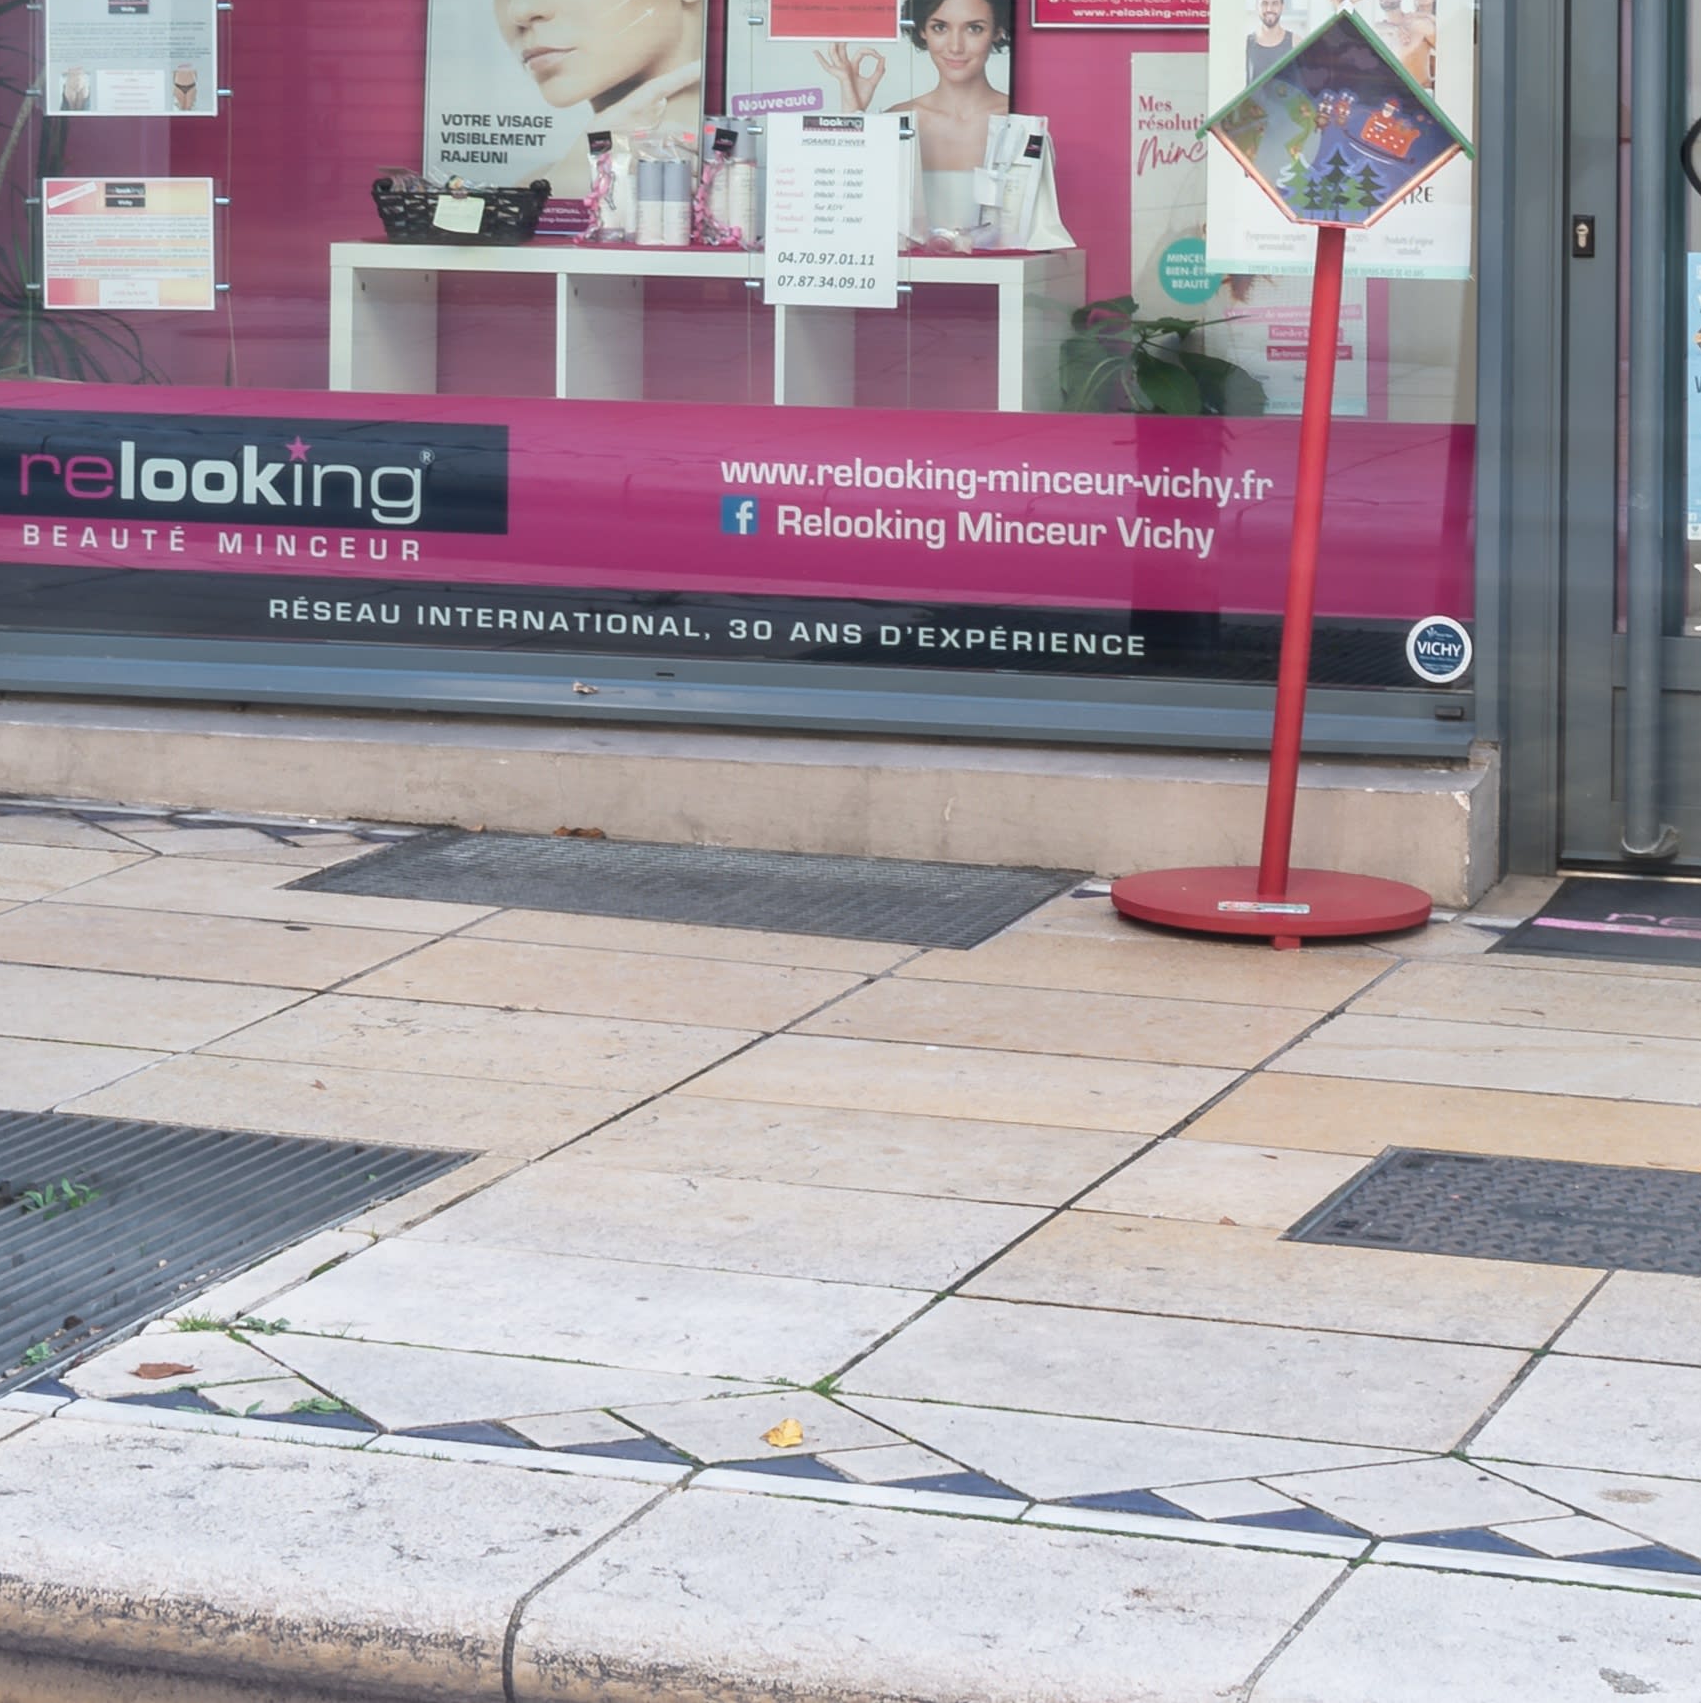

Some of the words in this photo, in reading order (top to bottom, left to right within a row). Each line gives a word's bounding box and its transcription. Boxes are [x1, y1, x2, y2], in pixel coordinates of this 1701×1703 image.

[737, 92, 817, 113] Nouveauté
[1138, 95, 1172, 112] Mes
[442, 114, 491, 127] VOTRE
[496, 115, 554, 129] VISAGE
[440, 131, 546, 147] VISIBLEMENT
[440, 150, 508, 164] RAJEUNI
[777, 251, 875, 266] 04.70.97.01.11
[777, 275, 876, 290] 07.87.34.09.10
[1171, 275, 1210, 289] BEAUTÉ
[720, 455, 1275, 509] www.relooking-minceur-vichy.fr
[776, 505, 947, 550] Relooking
[957, 510, 1107, 548] Minceur
[1117, 515, 1216, 559] Vichy
[22, 524, 187, 553] BEAUTÉ
[218, 531, 423, 563] MINCEUR
[268, 596, 401, 624] RÉSEAU
[728, 618, 773, 641] 30
[789, 620, 864, 646] ANS
[880, 624, 1147, 658] D'EXPÉRIENCE
[1416, 640, 1462, 658] VICHY
